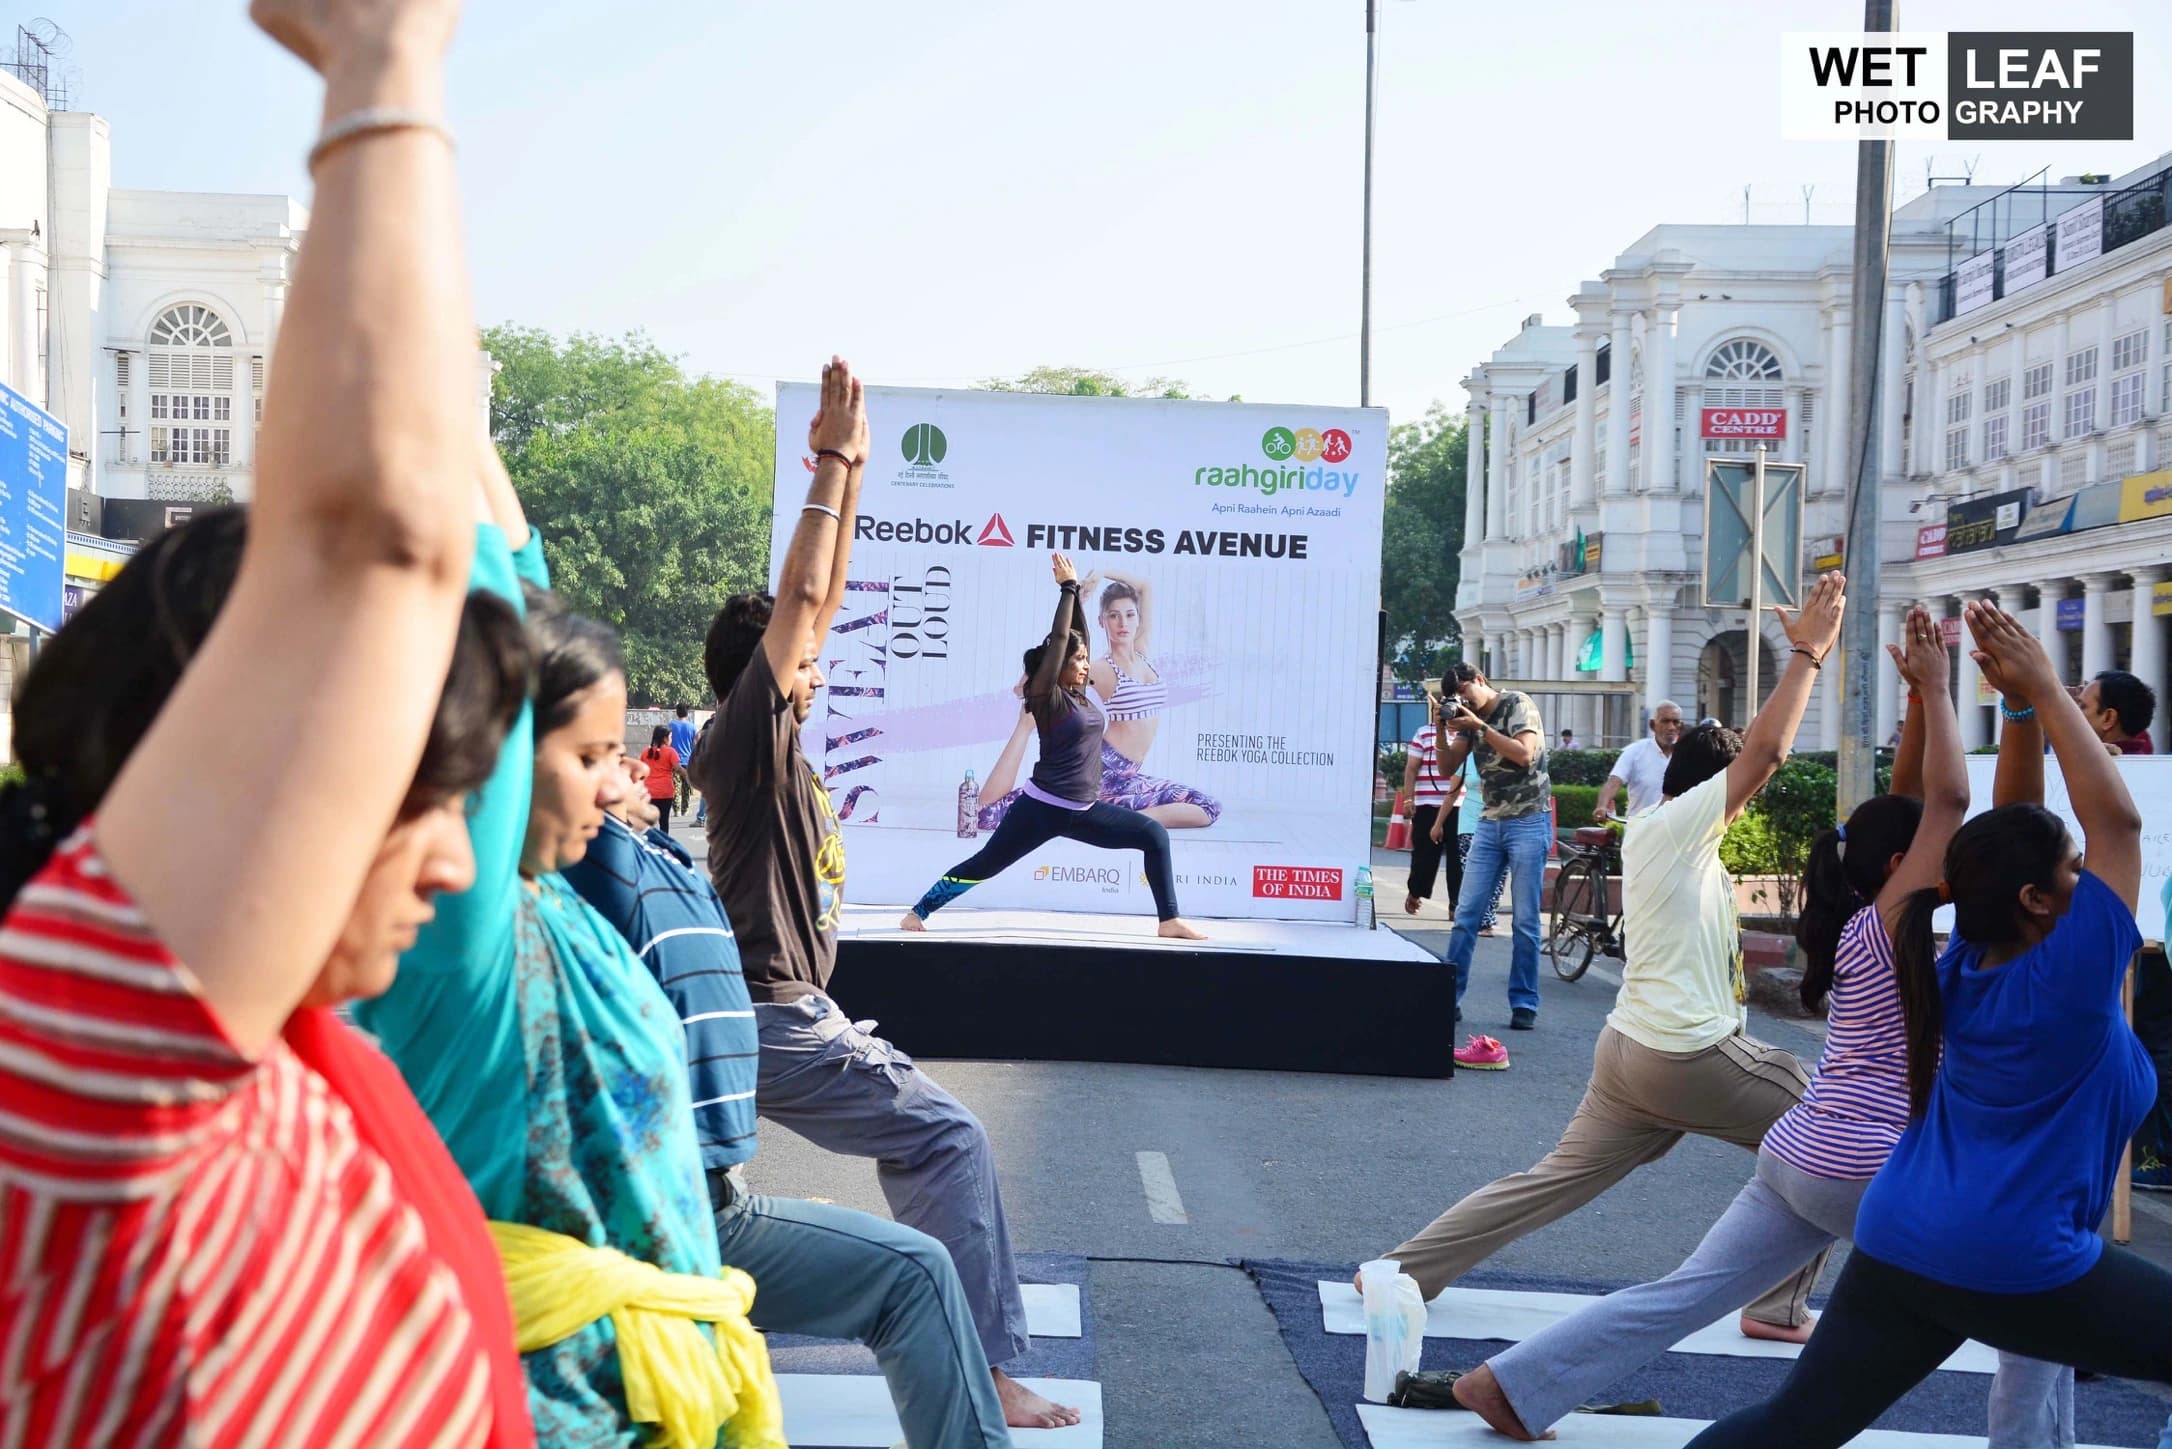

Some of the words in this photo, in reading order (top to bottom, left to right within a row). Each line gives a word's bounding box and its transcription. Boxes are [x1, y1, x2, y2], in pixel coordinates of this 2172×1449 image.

[1710, 412, 1779, 425] CADD
[1710, 425, 1778, 434] CENTRE
[1194, 464, 1359, 498] raahgiriday
[1211, 503, 1236, 514] Apni
[1237, 504, 1278, 515] Raahein
[1280, 506, 1305, 517] Apni
[1306, 507, 1342, 518] Azaadi
[854, 515, 973, 545] Reebok
[1027, 524, 1165, 554] FITNESS
[1173, 530, 1308, 559] AVENUE
[890, 576, 922, 659] OUT
[922, 566, 952, 658] LOUD
[1197, 734, 1263, 749] PRESENTING
[1267, 735, 1287, 750] THE
[1197, 748, 1238, 762] REEBOK
[1241, 749, 1268, 764] YOGA
[1271, 751, 1334, 765] COLLECTION
[1051, 866, 1120, 885] EMBARQ
[1176, 874, 1190, 884] RI
[1197, 875, 1238, 886] INDIA
[1256, 868, 1289, 882] THE
[1292, 869, 1340, 884] TIMES
[1262, 883, 1284, 896] OF
[1288, 884, 1332, 897] INDIA
